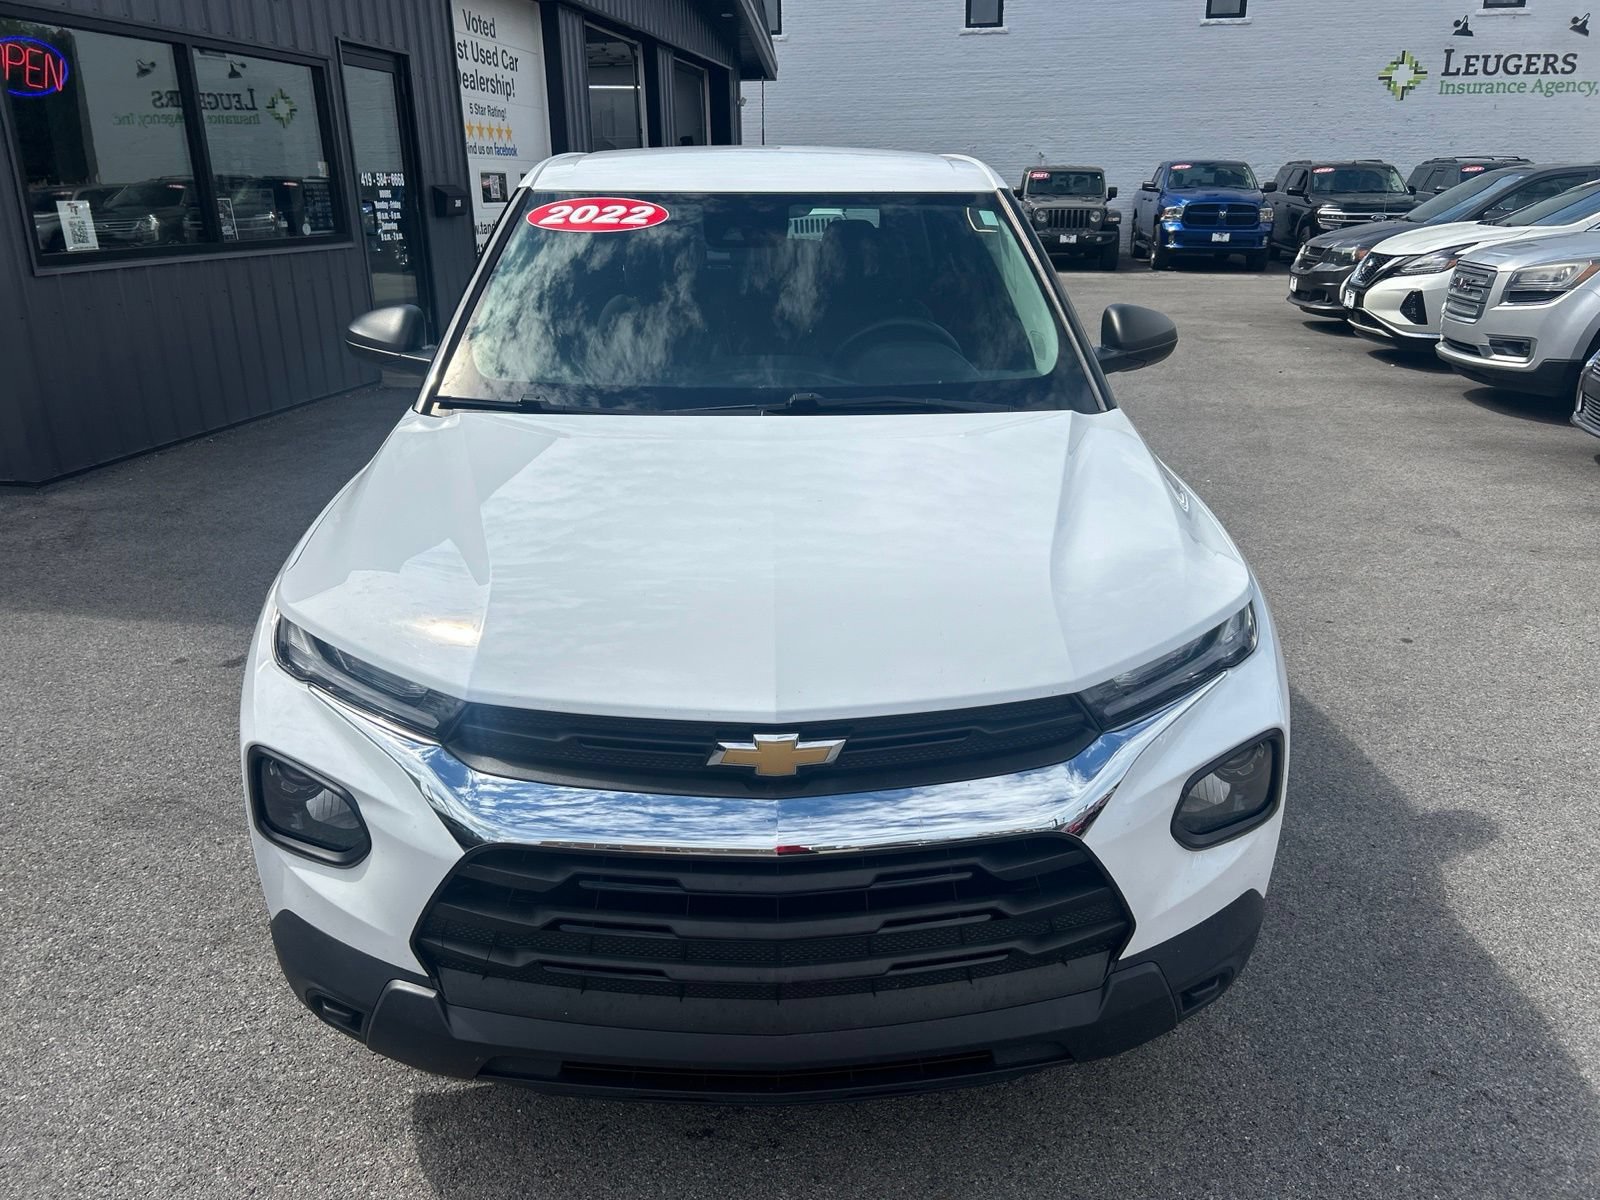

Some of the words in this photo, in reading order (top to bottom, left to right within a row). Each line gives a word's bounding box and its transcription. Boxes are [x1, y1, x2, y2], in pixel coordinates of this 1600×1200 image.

[462, 8, 496, 39] Voted
[0, 43, 63, 92] PEN
[457, 40, 469, 61] st
[470, 40, 499, 67] Used
[501, 49, 519, 72] Car
[1441, 48, 1578, 76] LEUGERS
[458, 69, 515, 102] ealership!
[1438, 80, 1527, 95] Insurance
[1530, 78, 1599, 97] Agency,
[469, 103, 474, 115] 5
[474, 103, 486, 116] Star
[487, 105, 507, 122] Rating!
[478, 145, 485, 155] us
[486, 146, 494, 156] on
[494, 142, 518, 157] facebook
[538, 205, 656, 224] 2022
